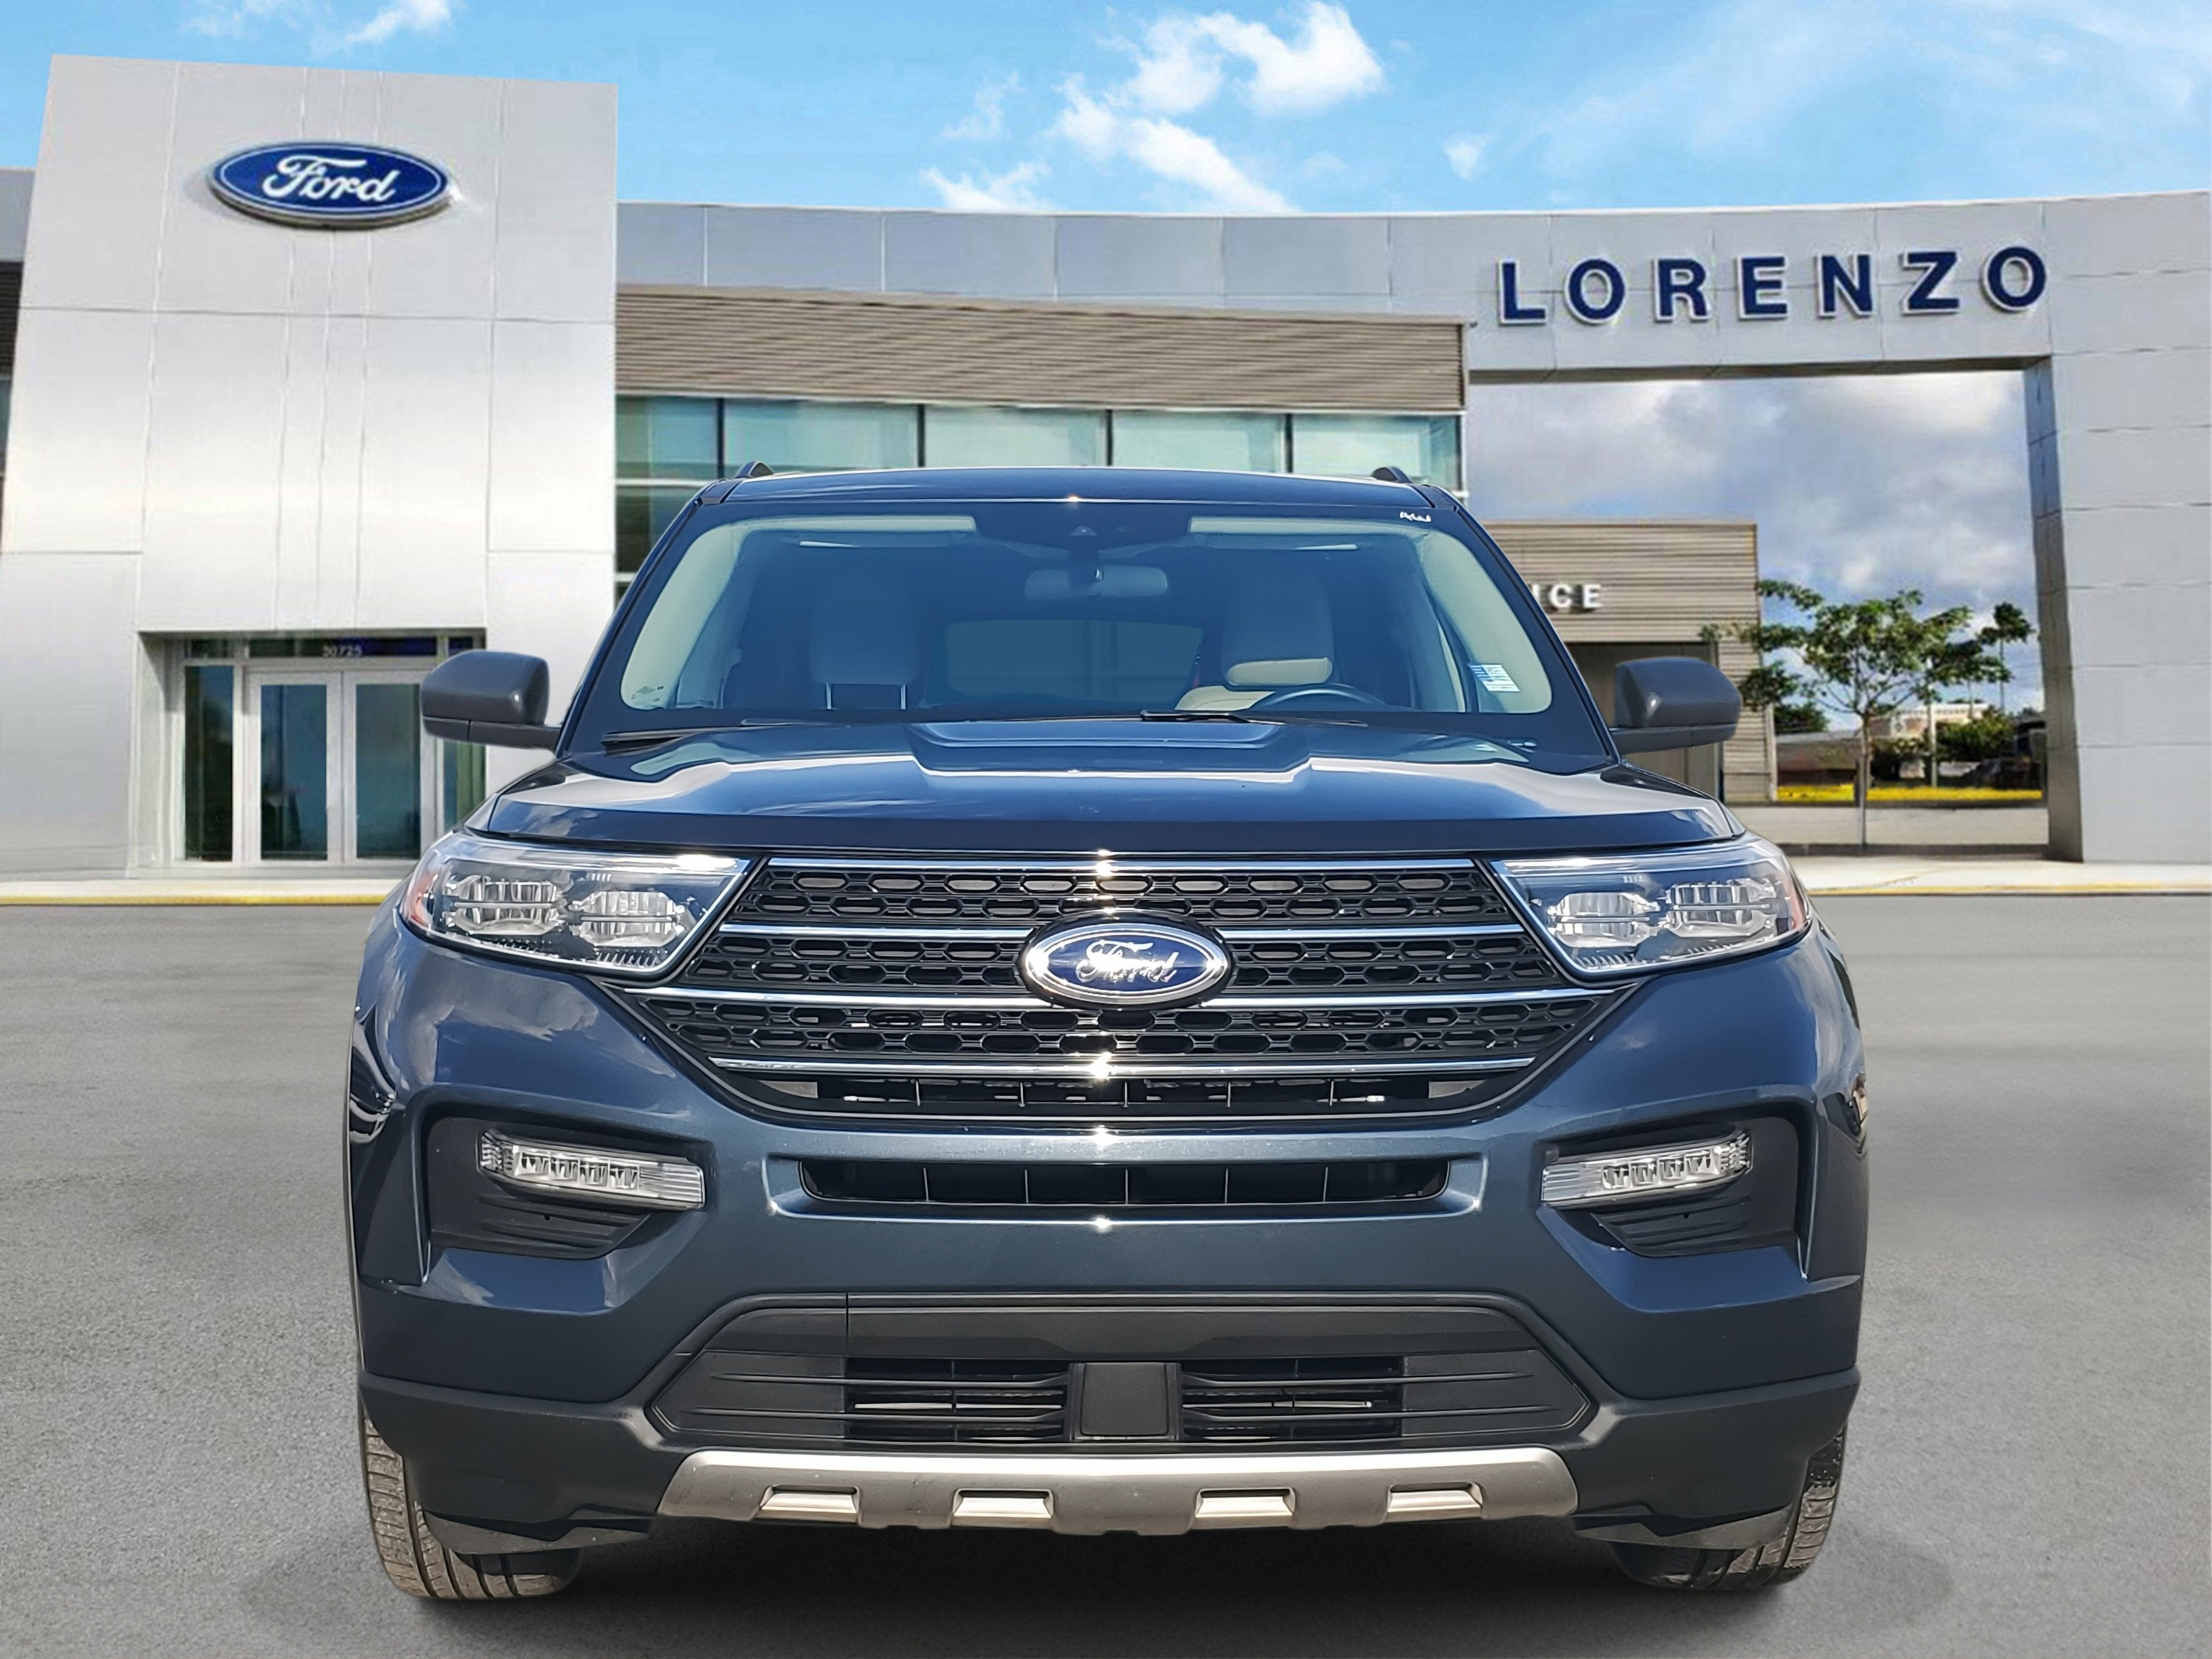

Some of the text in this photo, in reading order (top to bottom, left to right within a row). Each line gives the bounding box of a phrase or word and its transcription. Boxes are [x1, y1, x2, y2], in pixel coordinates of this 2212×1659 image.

[262, 154, 400, 201] Ford
[1499, 246, 2047, 325] LORENZO
[1075, 939, 1179, 983] Ford
